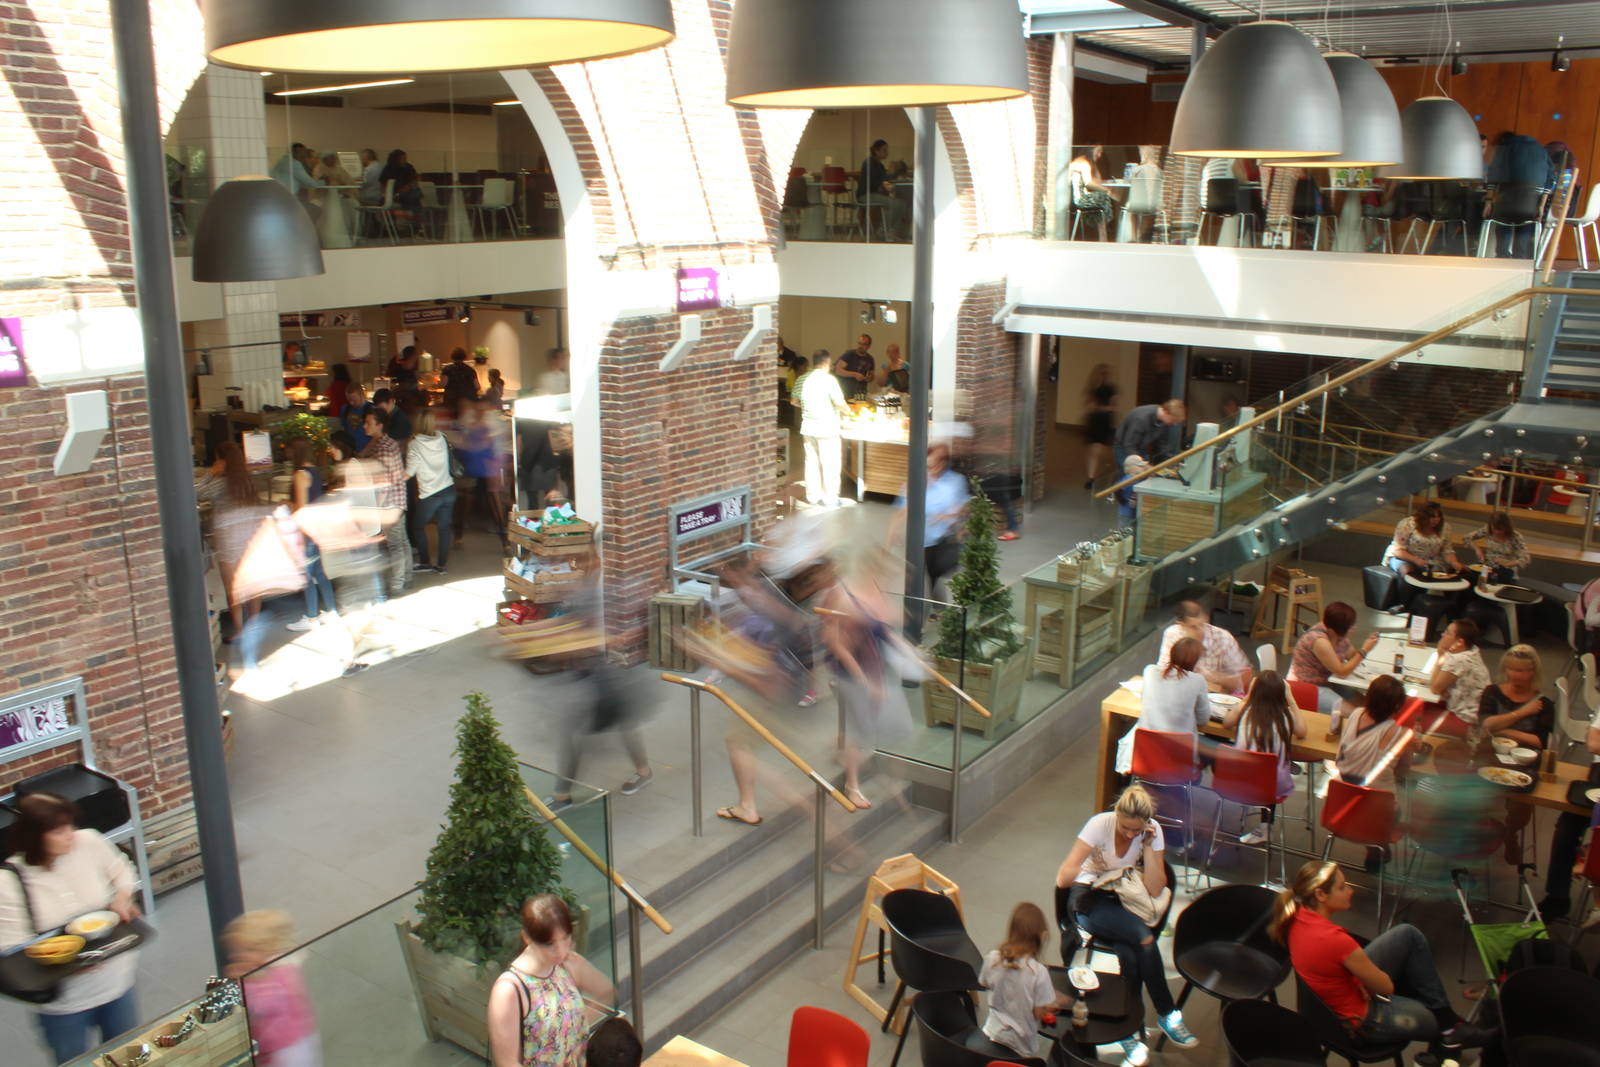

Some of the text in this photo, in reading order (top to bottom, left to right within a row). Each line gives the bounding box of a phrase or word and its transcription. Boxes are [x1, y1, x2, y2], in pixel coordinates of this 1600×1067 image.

[422, 309, 447, 317] CORNER
[679, 521, 695, 531] TAKE
[700, 514, 716, 525] TRAY
[680, 511, 704, 523] PLEASE
